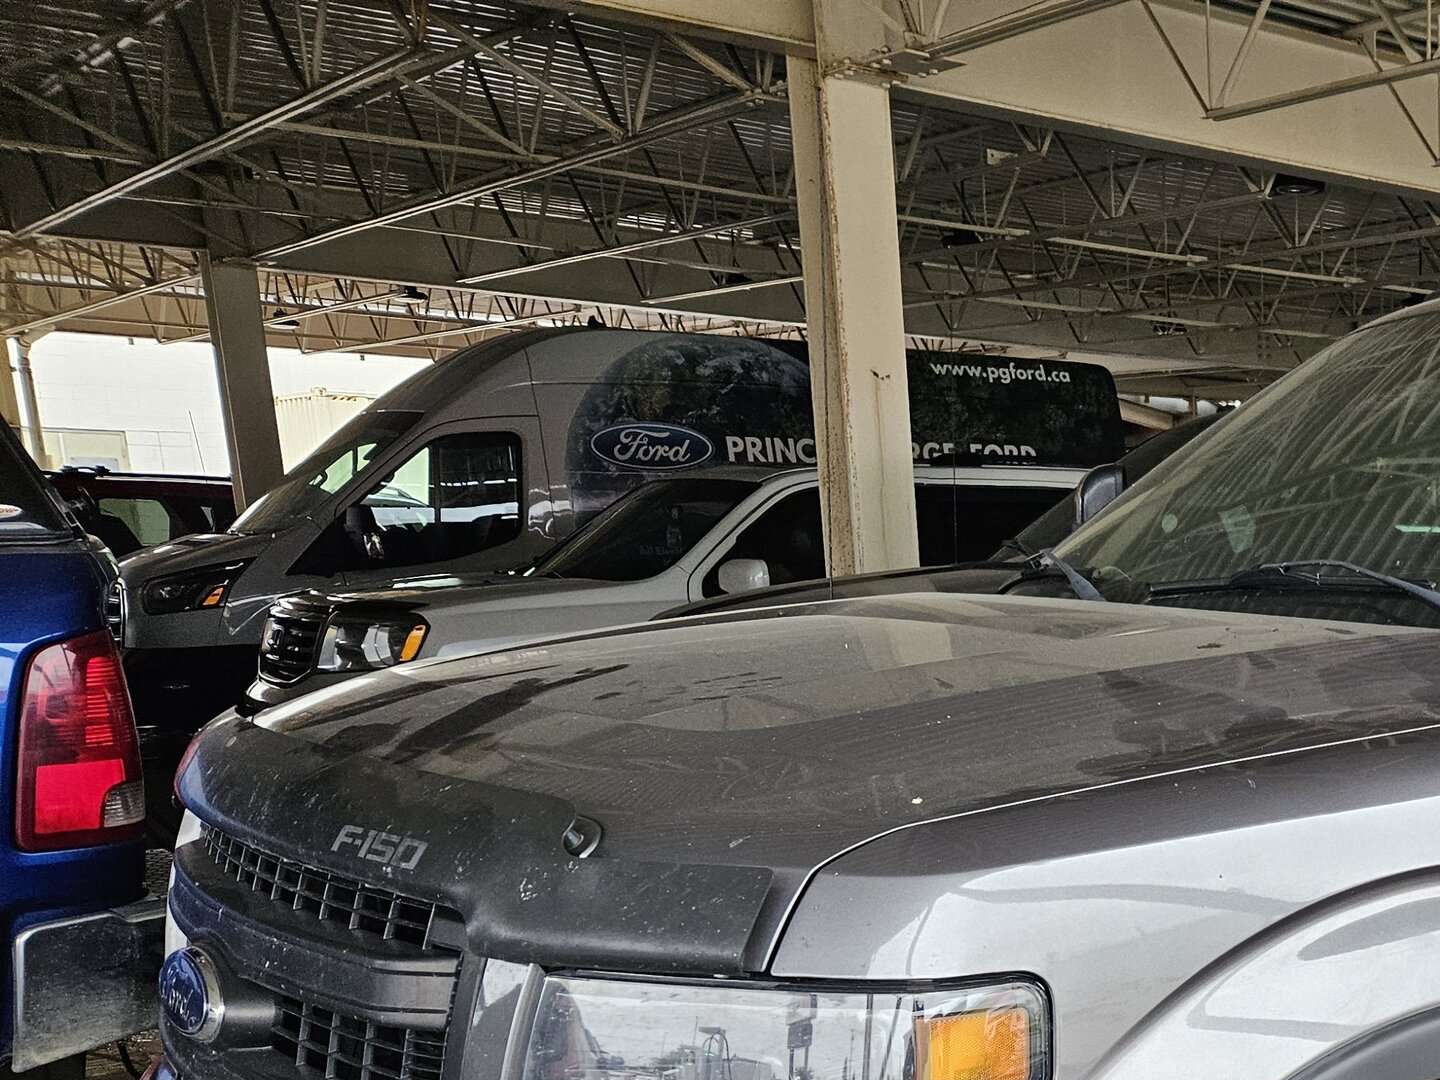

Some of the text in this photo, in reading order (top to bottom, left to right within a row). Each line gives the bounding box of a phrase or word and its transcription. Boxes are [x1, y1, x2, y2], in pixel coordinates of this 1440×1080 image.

[930, 362, 1071, 384] www.pgford.ca
[614, 428, 691, 463] Ford
[725, 435, 818, 464] PRINC
[330, 824, 429, 870] F-150
